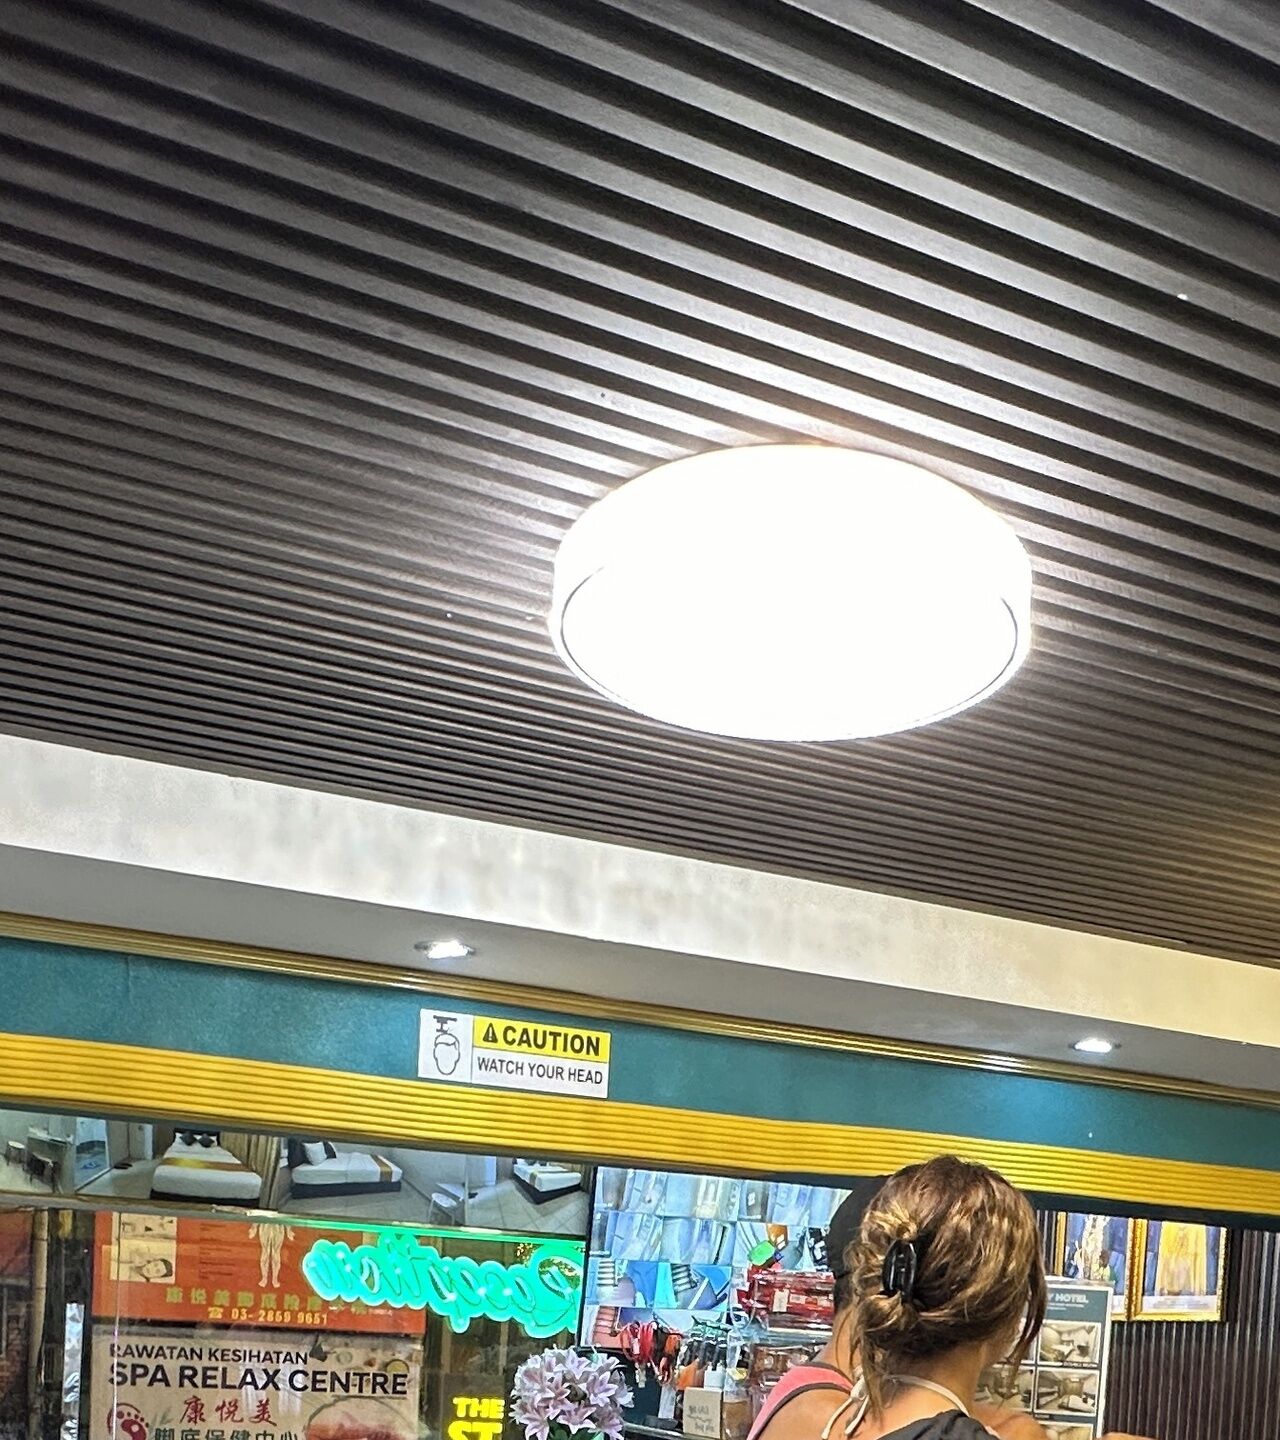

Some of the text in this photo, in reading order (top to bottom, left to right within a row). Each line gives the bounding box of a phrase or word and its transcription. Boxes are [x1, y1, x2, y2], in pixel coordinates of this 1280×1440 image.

[503, 1025, 600, 1056] CAUTION
[477, 1056, 603, 1084] WATCH YOUR HEAD
[1055, 1293, 1089, 1303] HOTEL
[109, 1343, 308, 1365] RAWATAN KESIHATAN
[108, 1363, 408, 1395] SPA RELAX CENTRE
[453, 1397, 505, 1419] THE
